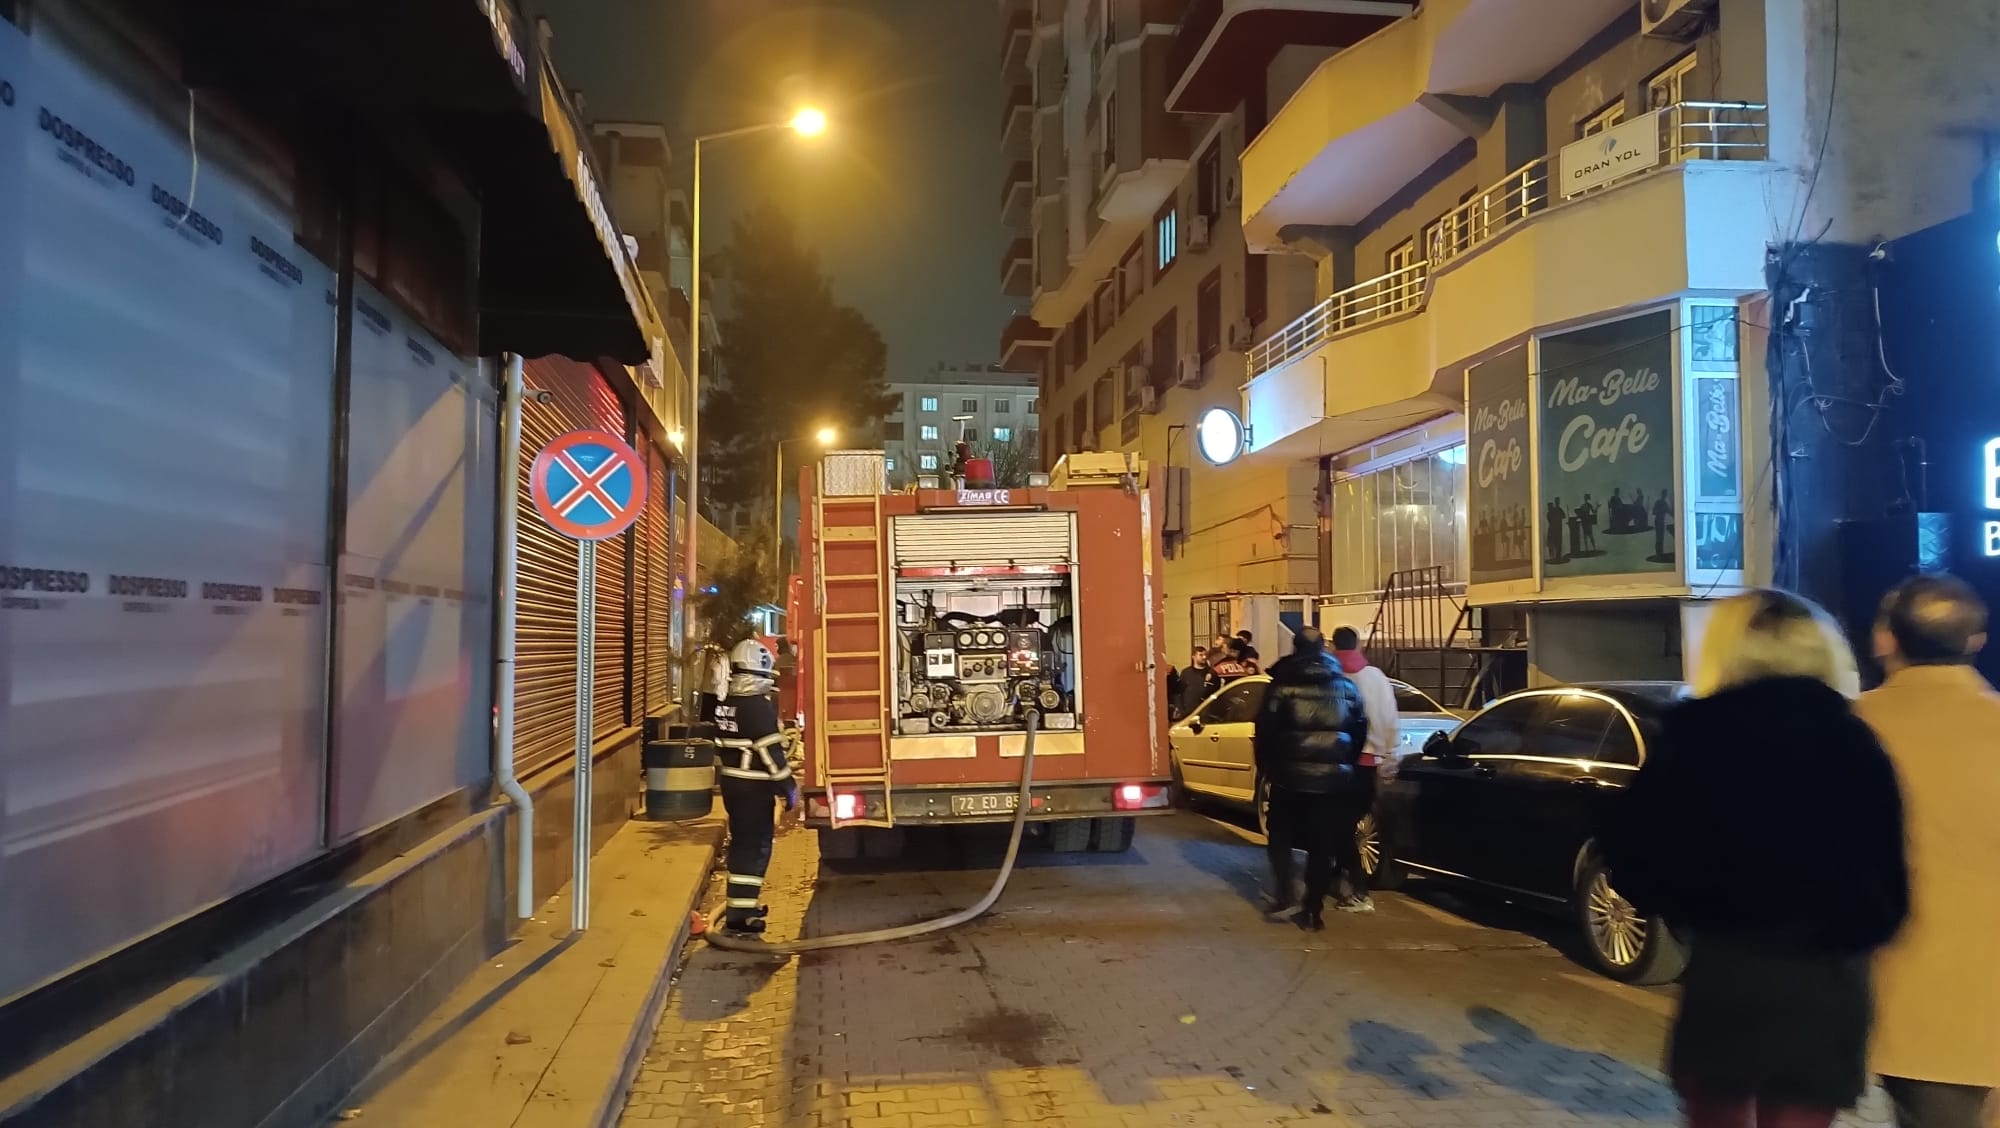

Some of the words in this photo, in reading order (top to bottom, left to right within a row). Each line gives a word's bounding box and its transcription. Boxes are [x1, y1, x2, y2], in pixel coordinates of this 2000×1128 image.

[39, 105, 135, 186] DOSPRESSO
[1574, 160, 1610, 179] ORAN
[1615, 148, 1641, 164] YOL
[1547, 367, 1660, 409] Ma-Belle
[1473, 398, 1527, 434] Ma-Belle
[1558, 412, 1650, 473] Cafe
[1478, 437, 1522, 488] Cafe
[994, 489, 1009, 504] CE
[959, 797, 975, 810] 72
[982, 796, 998, 809] ED
